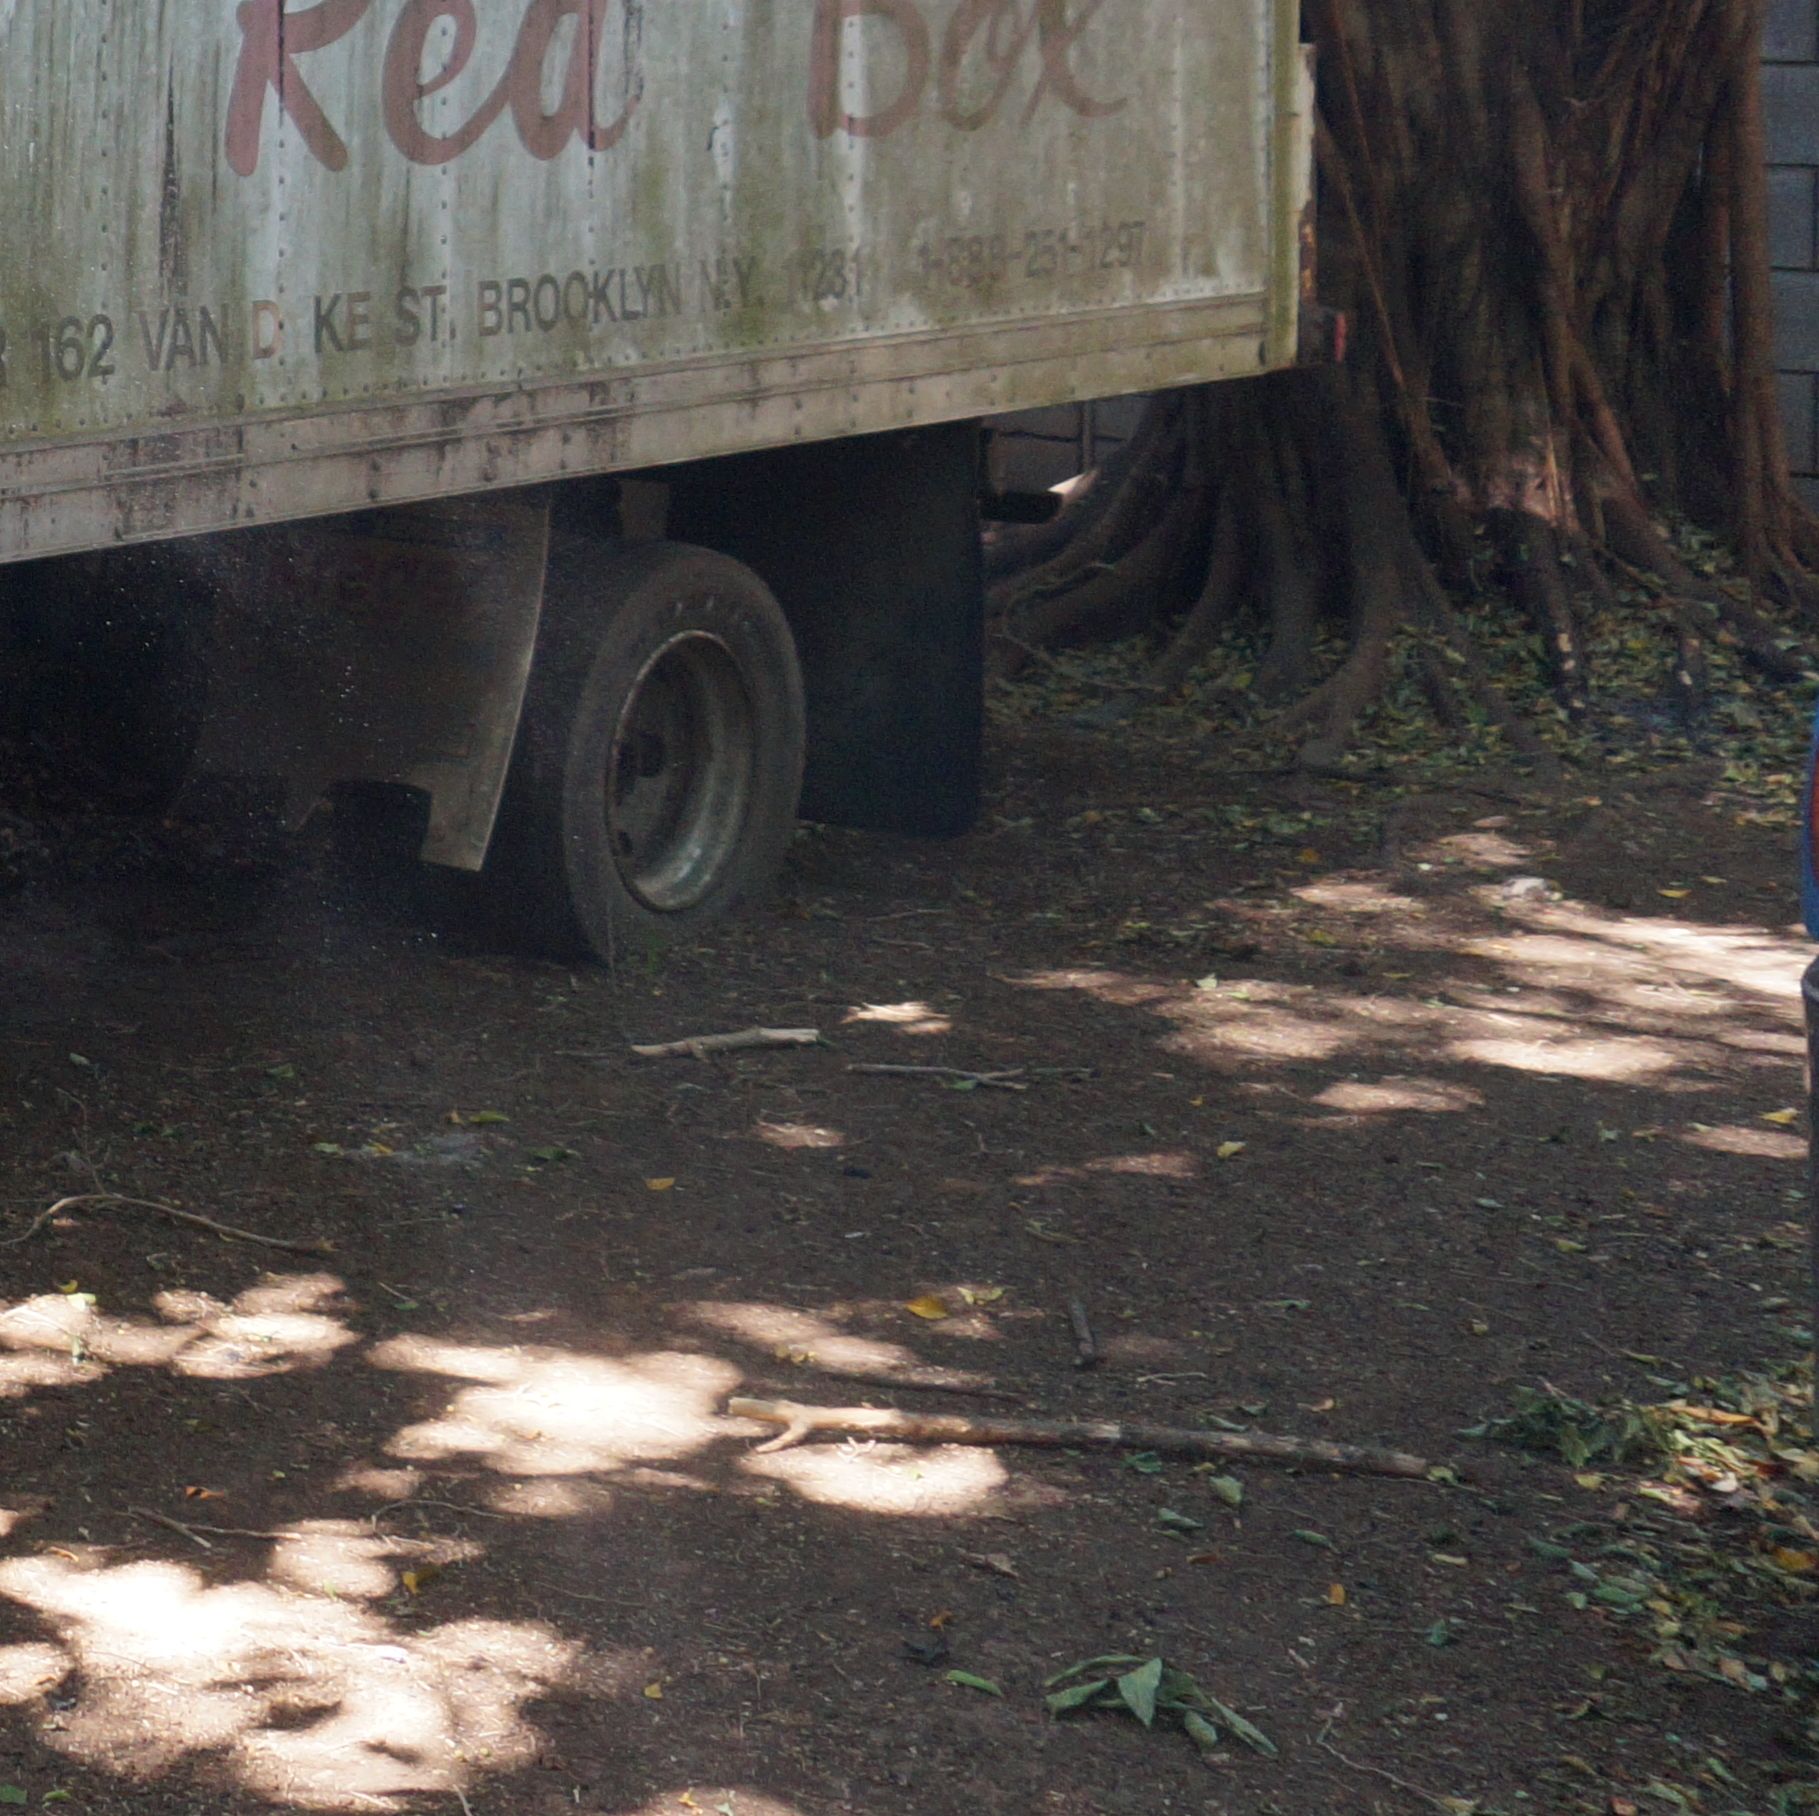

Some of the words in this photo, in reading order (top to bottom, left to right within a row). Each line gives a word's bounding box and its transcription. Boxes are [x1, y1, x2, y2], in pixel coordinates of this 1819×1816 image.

[32, 313, 116, 384] 162
[134, 305, 229, 371] VAN
[478, 263, 681, 337] BROOKLYN
